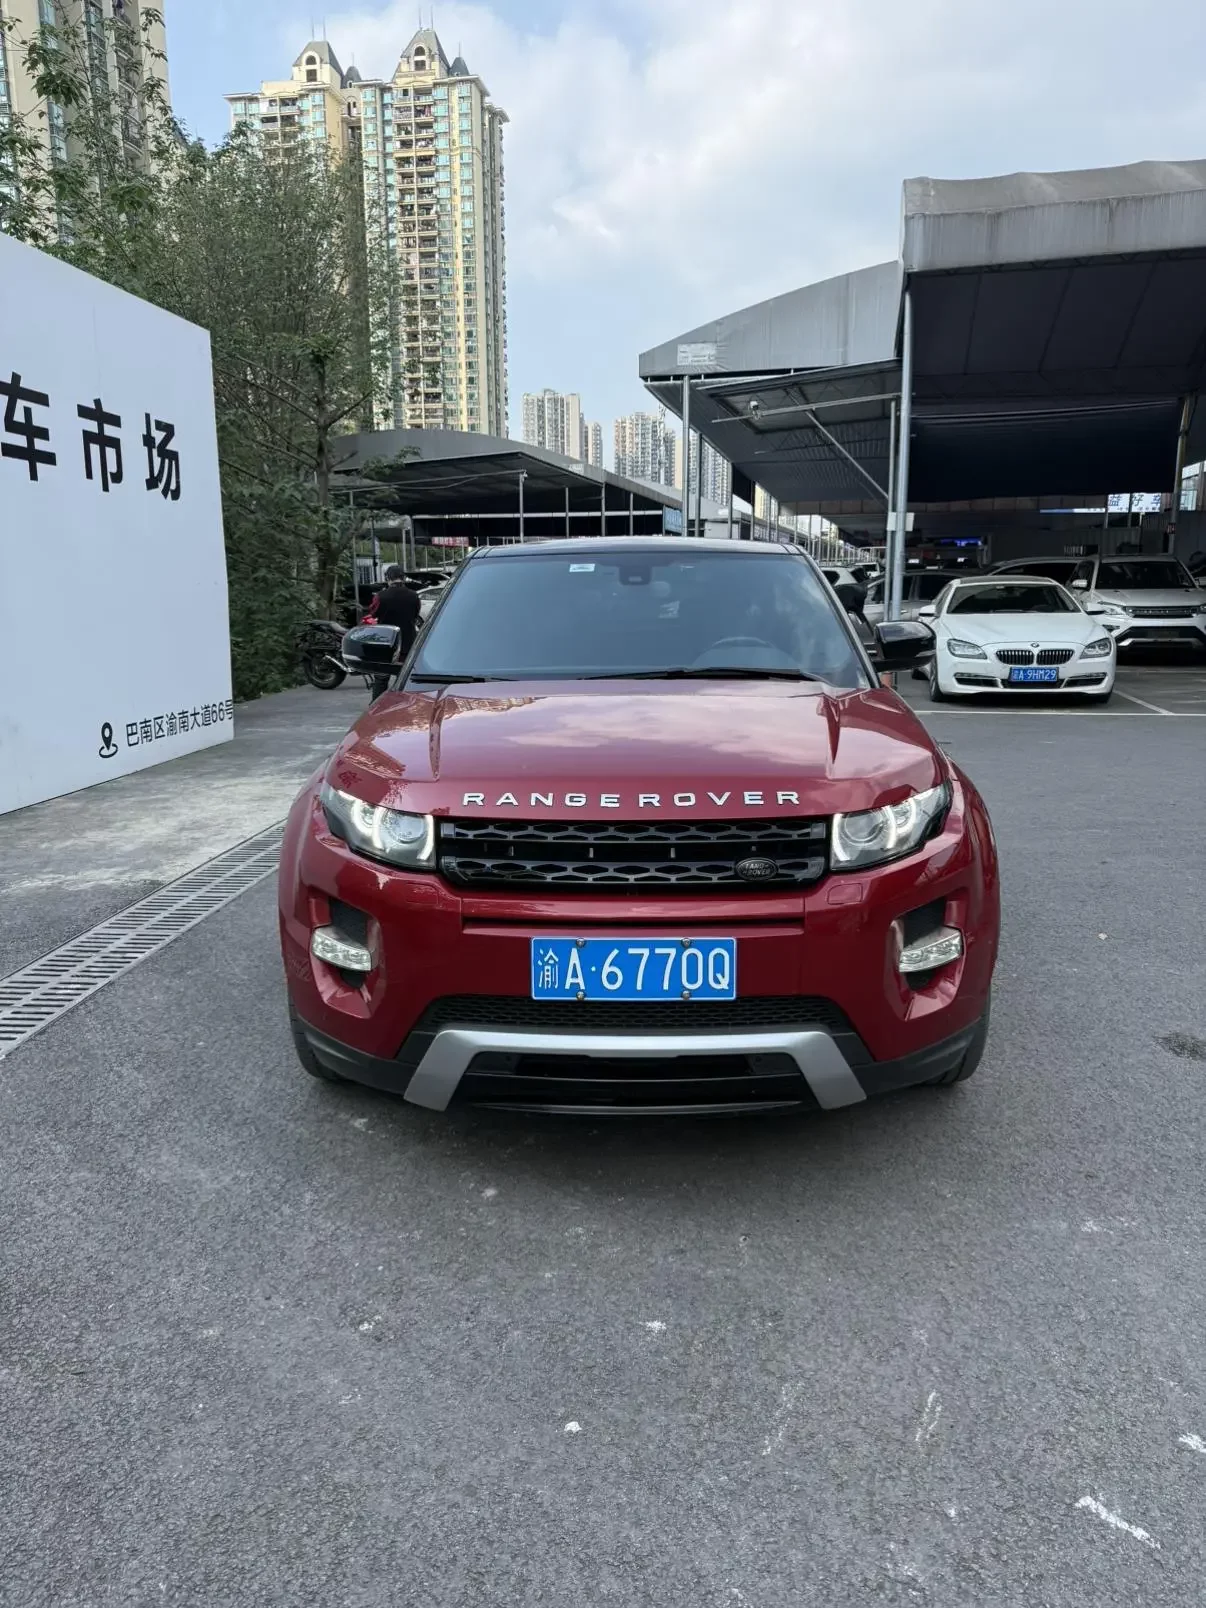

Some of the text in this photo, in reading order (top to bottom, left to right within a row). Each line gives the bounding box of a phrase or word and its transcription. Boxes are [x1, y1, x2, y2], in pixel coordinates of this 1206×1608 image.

[0, 371, 181, 501] 车市场
[125, 699, 234, 747] 巴南区渝南大道66号
[462, 790, 800, 808] RANGE ROVER
